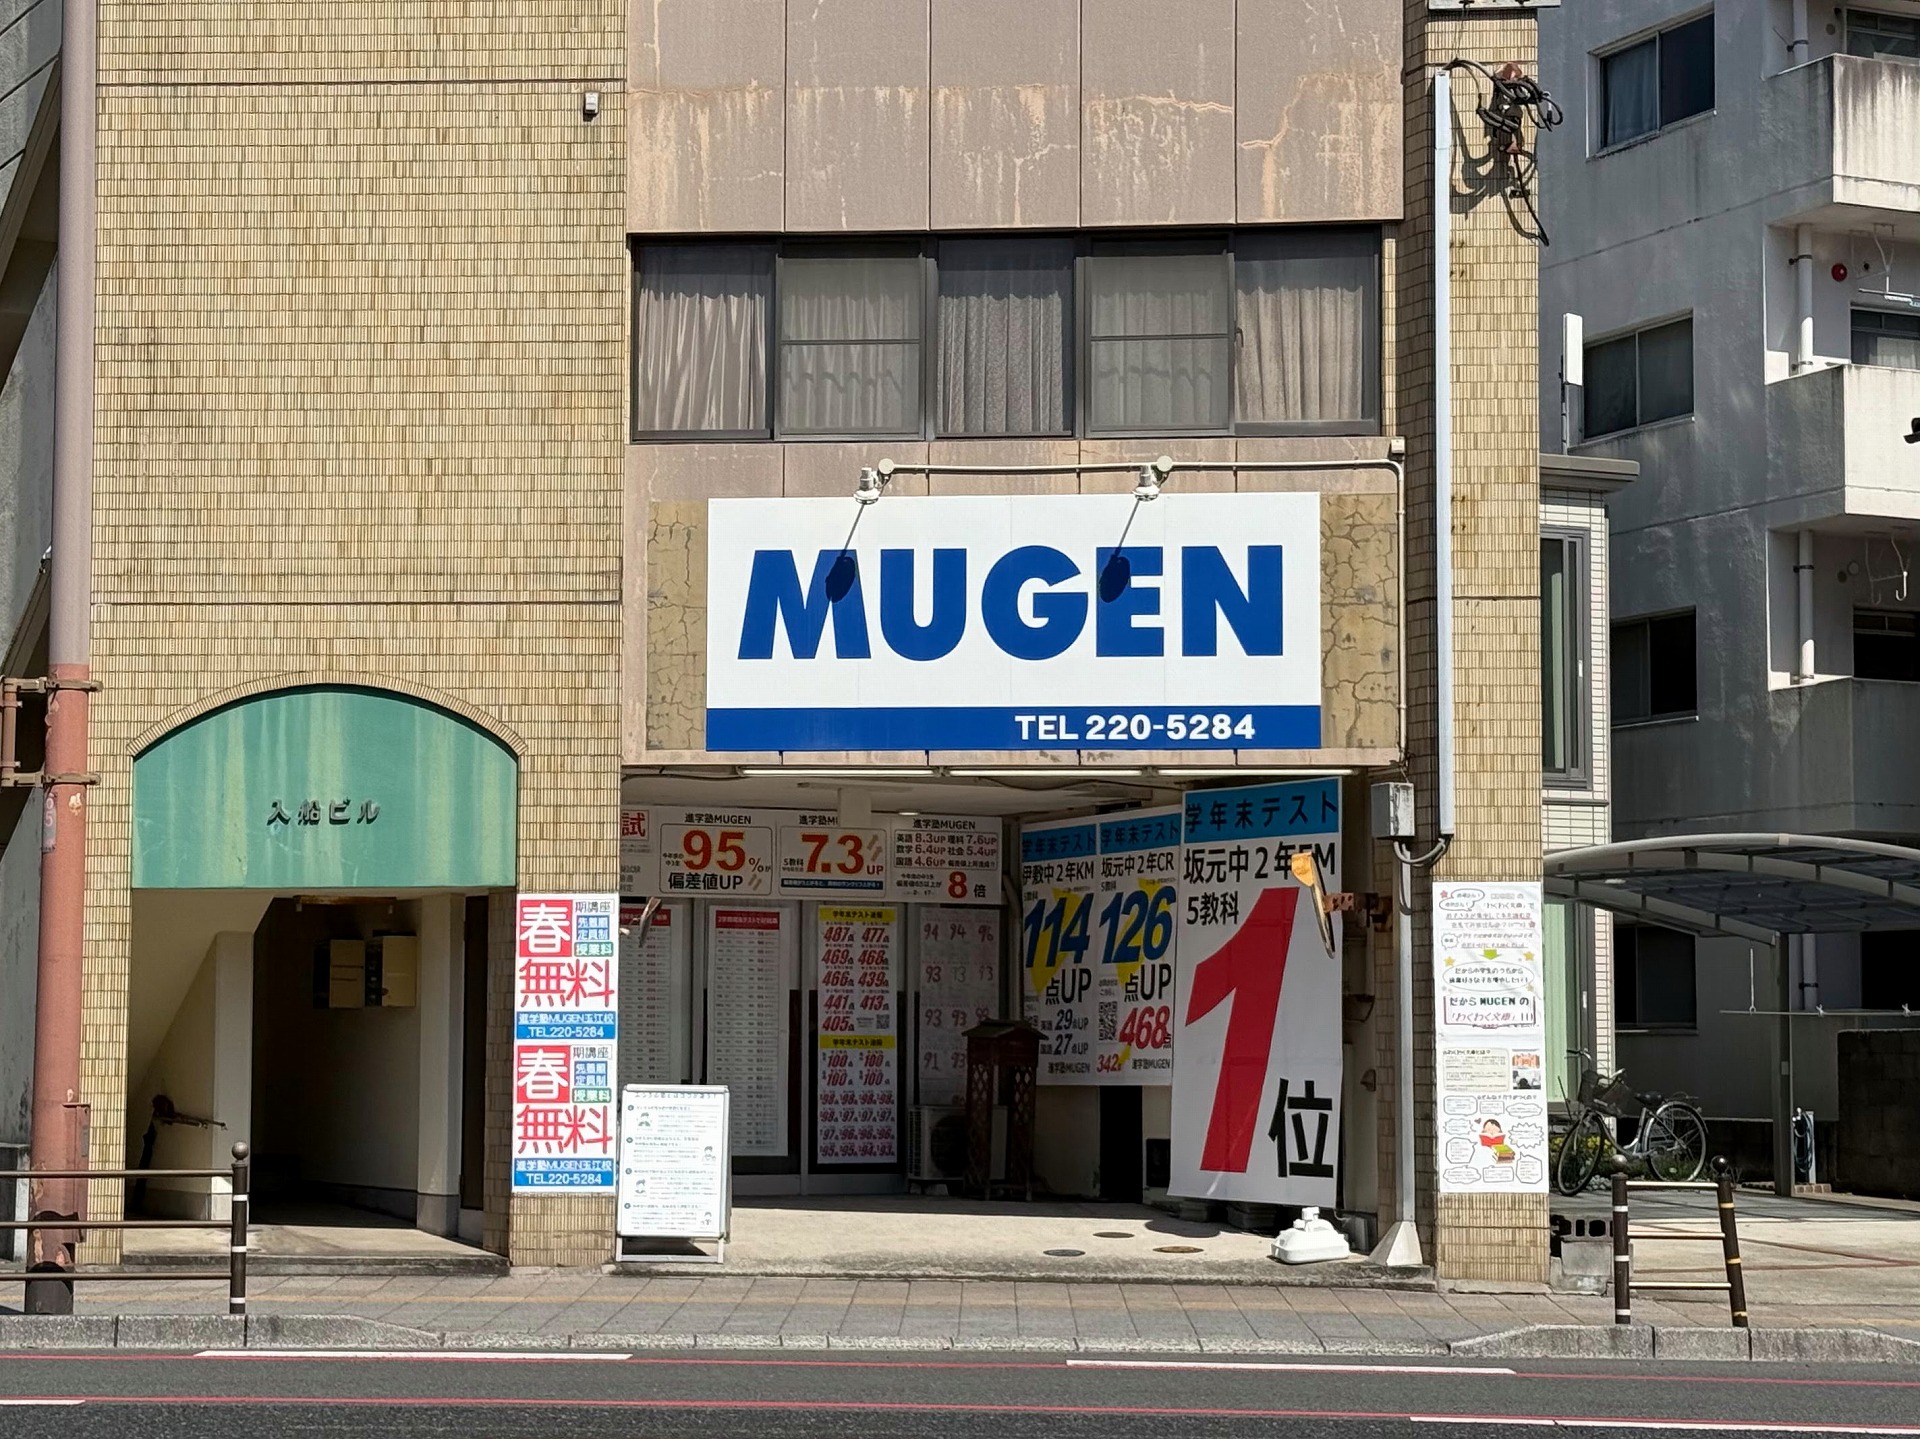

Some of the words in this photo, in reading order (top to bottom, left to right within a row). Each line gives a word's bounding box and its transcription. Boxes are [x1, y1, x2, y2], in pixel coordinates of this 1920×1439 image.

[738, 545, 1283, 661] MUGEN
[266, 797, 381, 825] 入船ビル
[684, 812, 751, 824] 進学塾MUGEN
[912, 818, 975, 830] 進学塾MUGEN
[1185, 790, 1338, 834] 学年末テスト
[1022, 832, 1095, 857] 学年末テスト
[1101, 820, 1179, 846] 学年末テスト
[668, 872, 744, 890] 偏差値UP
[1183, 842, 1336, 883] 坂元中2年M
[1099, 885, 1177, 964] 126
[1186, 891, 1239, 925] 5教科
[520, 902, 571, 953] 春
[1024, 893, 1094, 968] 114
[576, 943, 613, 956] 授業料
[519, 958, 615, 1008] 無料
[1045, 968, 1092, 1005] 点UP
[1124, 963, 1172, 1002] 点UP
[1450, 996, 1477, 1006] だから
[1480, 997, 1516, 1006] MUGEN
[1520, 997, 1530, 1006] の
[517, 1048, 568, 1100] 春
[574, 1089, 610, 1102] 授業料
[516, 1105, 613, 1154] 無料
